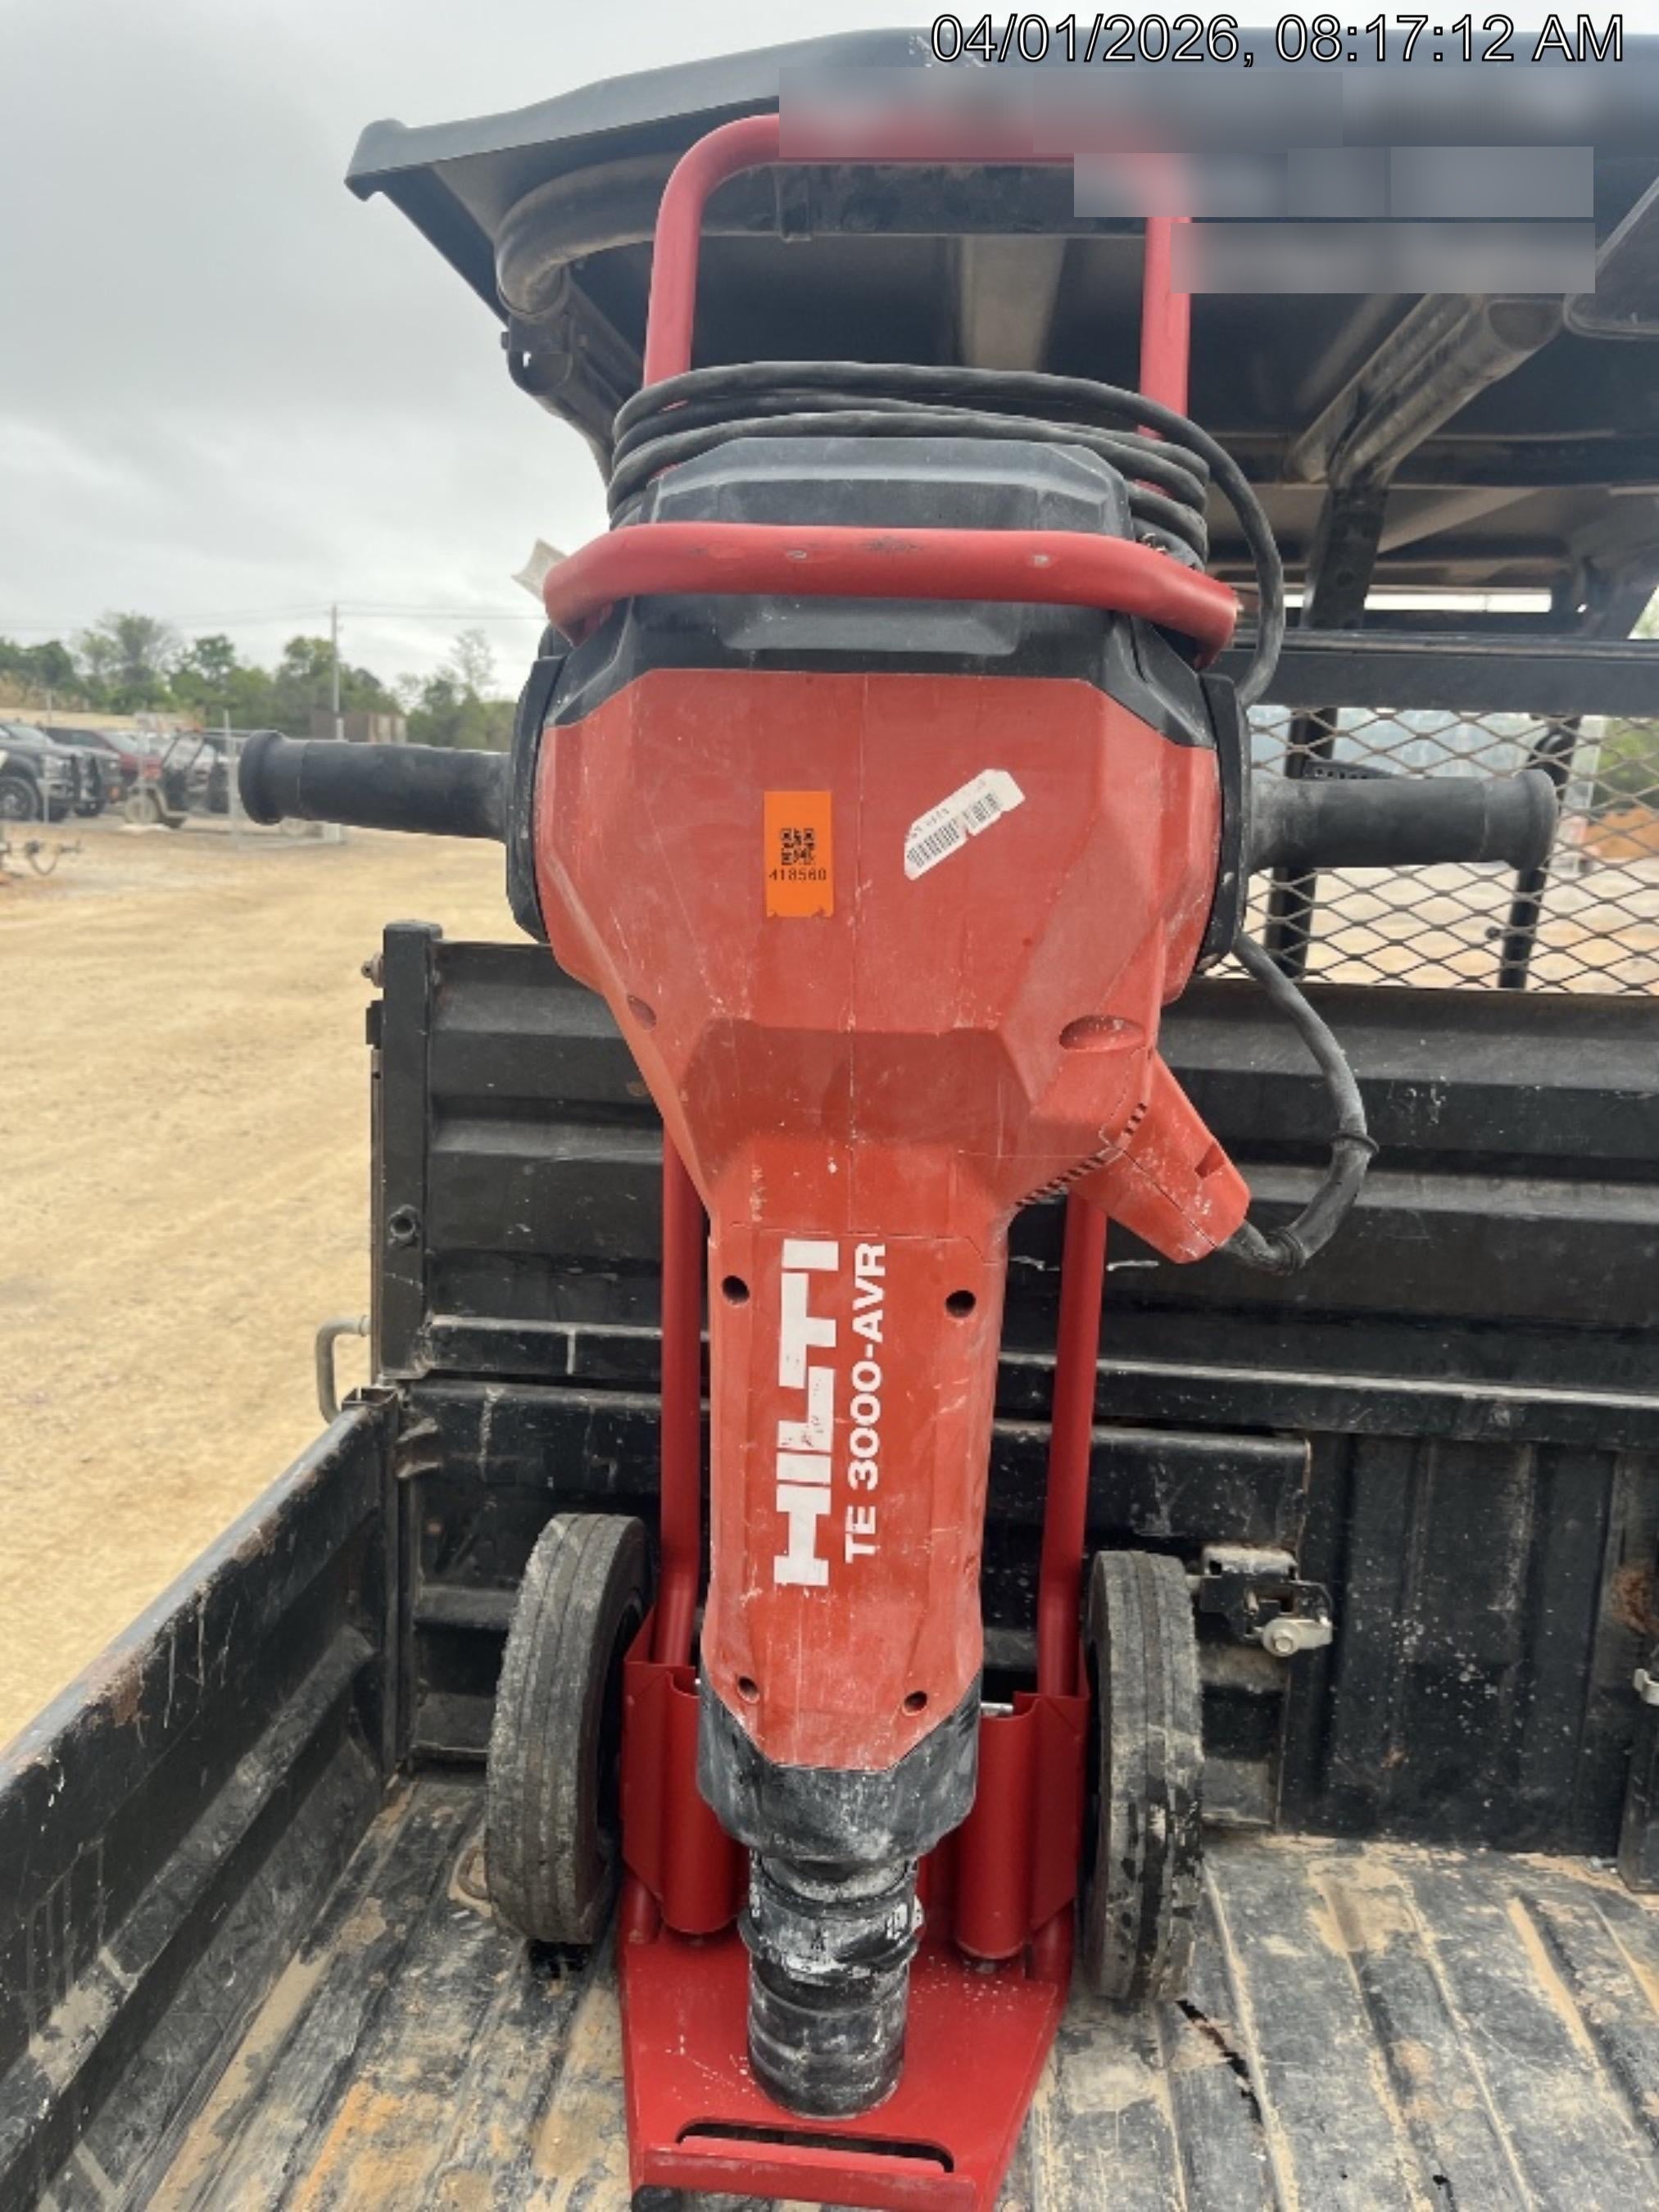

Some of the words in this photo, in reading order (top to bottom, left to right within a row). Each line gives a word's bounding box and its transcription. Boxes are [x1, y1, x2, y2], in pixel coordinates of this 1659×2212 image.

[773, 1238, 839, 1586] HILTI
[847, 1242, 886, 1491] 3000-AVR
[845, 1504, 879, 1564] TE
